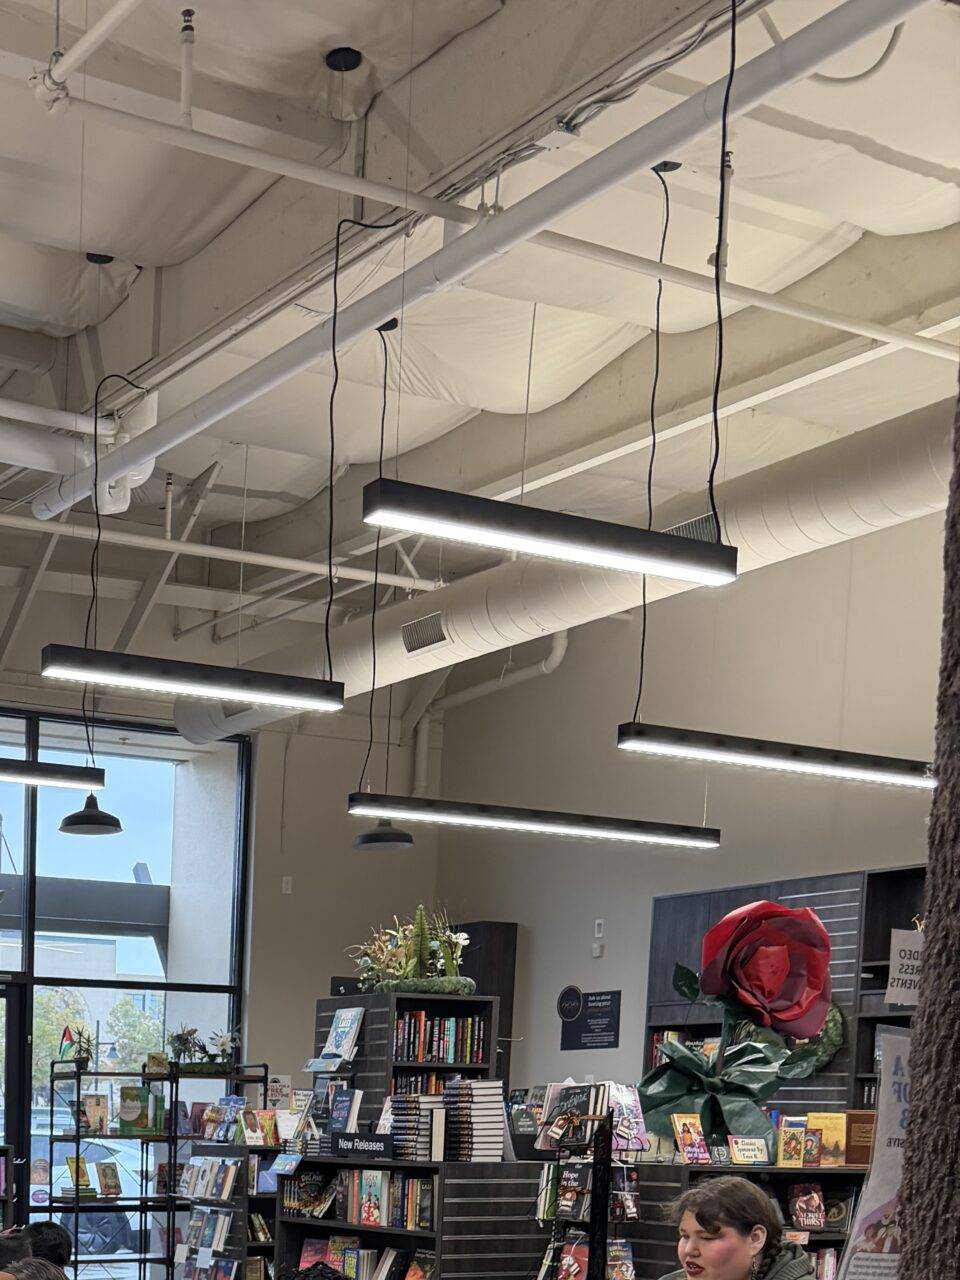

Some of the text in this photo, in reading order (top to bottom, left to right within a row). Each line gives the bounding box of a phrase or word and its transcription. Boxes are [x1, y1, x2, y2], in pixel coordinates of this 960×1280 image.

[339, 1139, 384, 1151] New Releases
[563, 1171, 578, 1179] Hope
